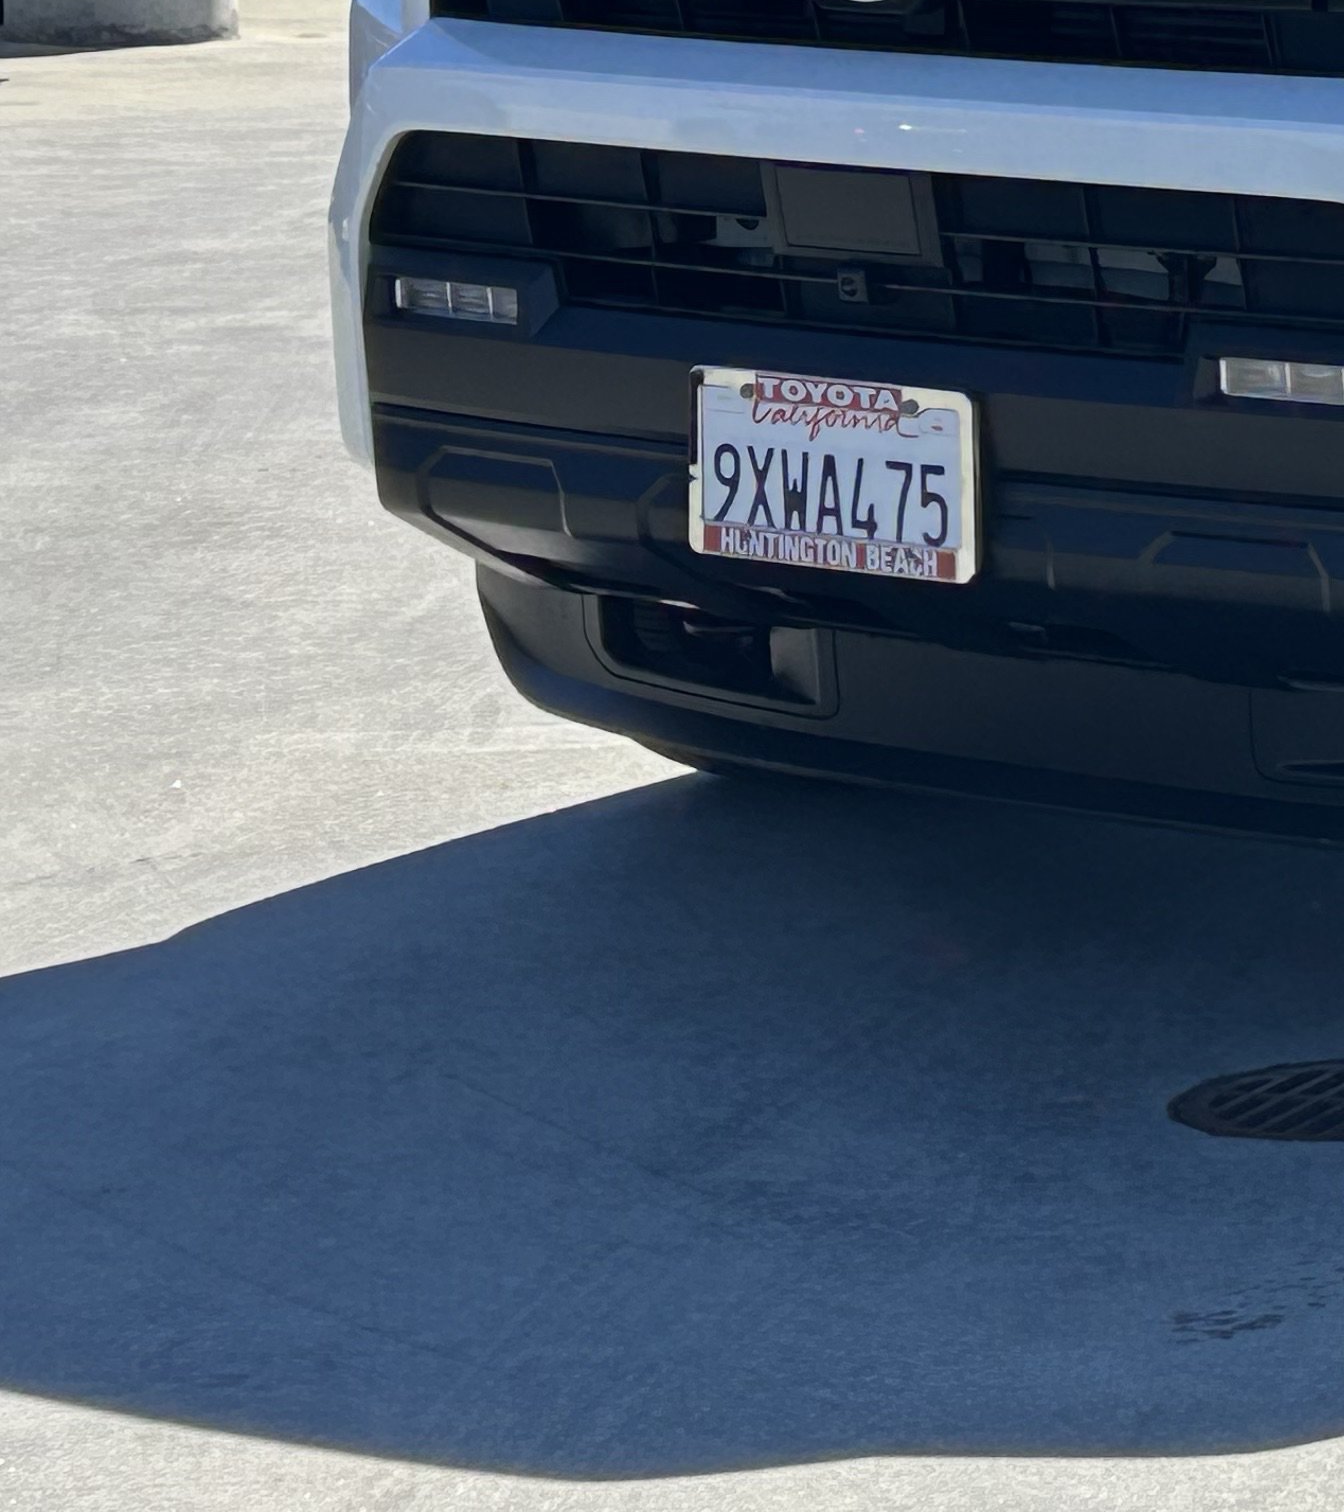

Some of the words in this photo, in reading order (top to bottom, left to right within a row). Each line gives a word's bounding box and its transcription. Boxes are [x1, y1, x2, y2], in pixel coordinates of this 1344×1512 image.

[757, 378, 899, 411] TOYOTA
[752, 399, 919, 441] California
[714, 443, 949, 547] 9XWA475
[721, 527, 857, 567] HUNTINGTON
[866, 544, 938, 577] BEACH
